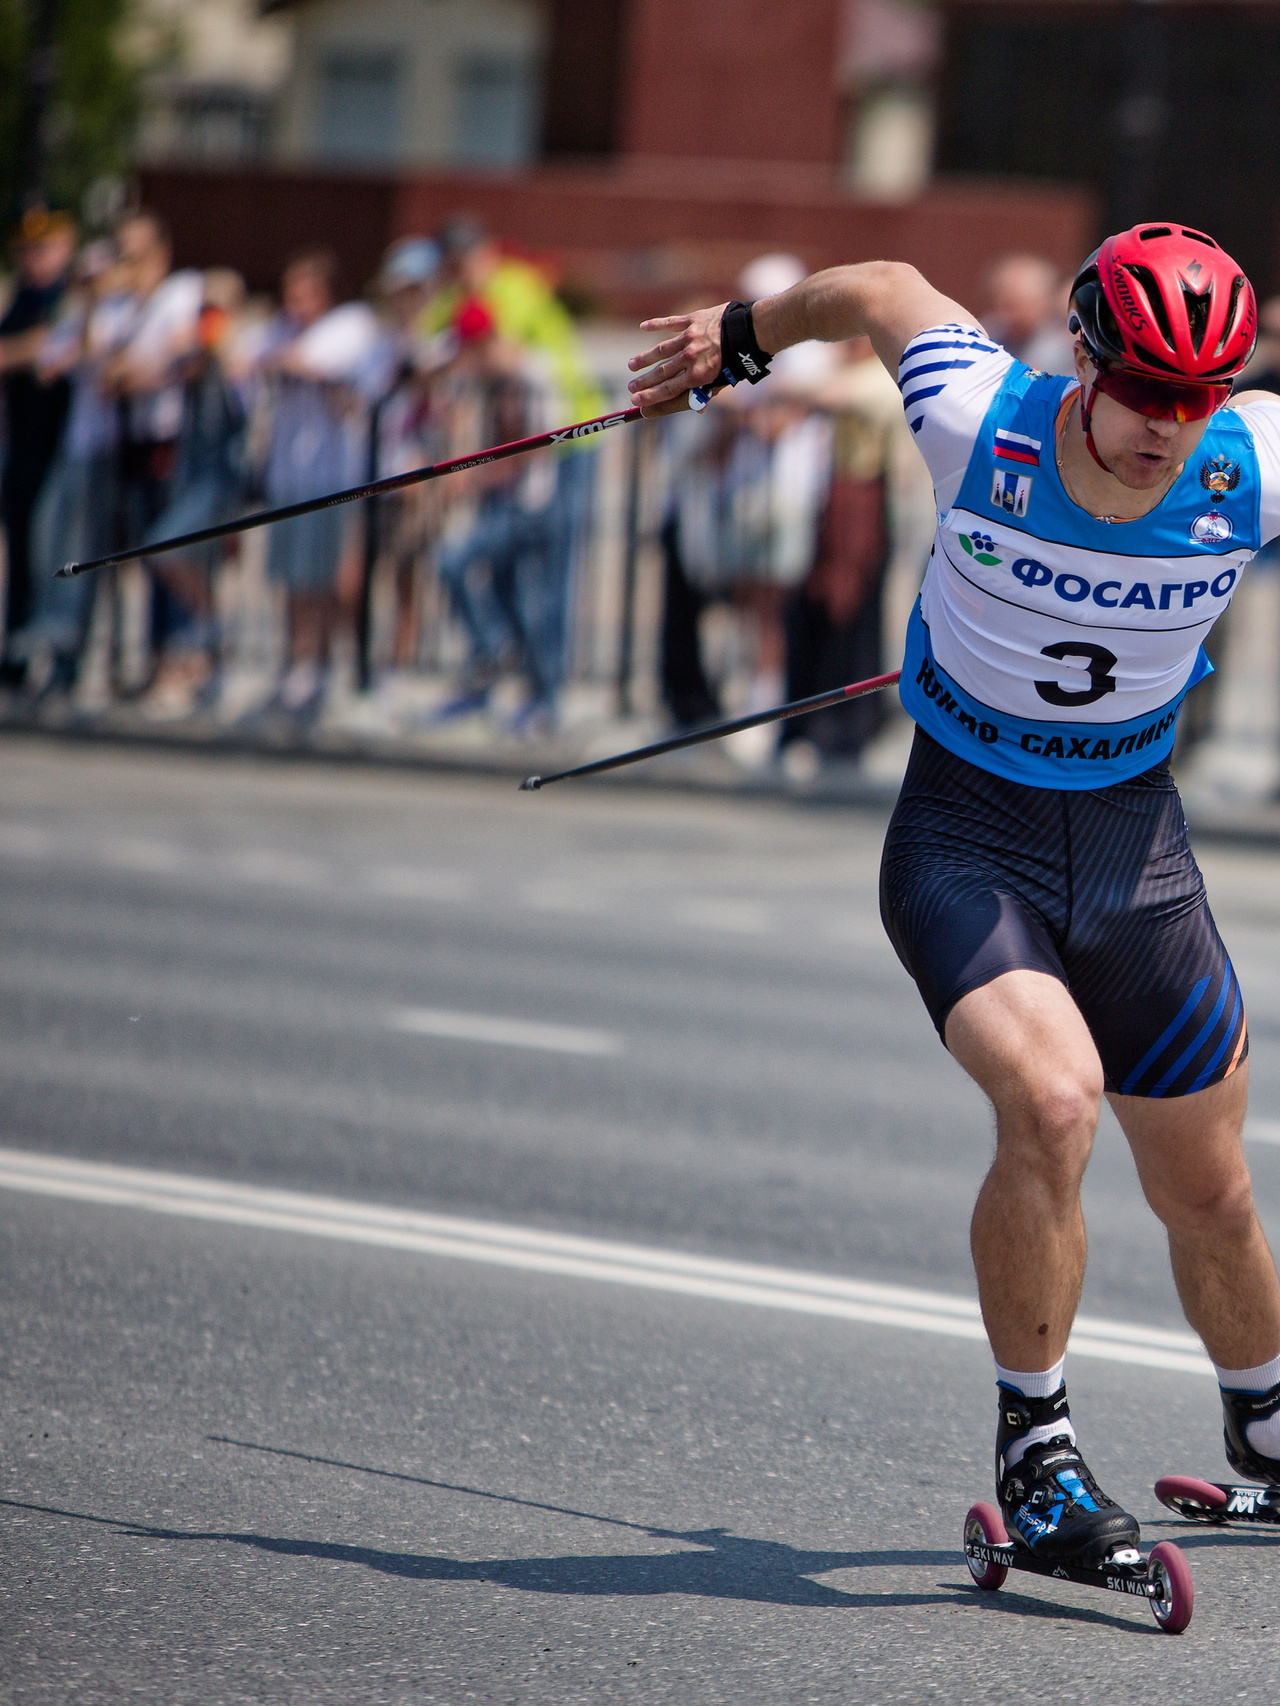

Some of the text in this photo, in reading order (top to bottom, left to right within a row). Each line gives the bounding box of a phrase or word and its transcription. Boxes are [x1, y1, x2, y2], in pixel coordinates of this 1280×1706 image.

[1111, 254, 1150, 332] S-WORKS
[1011, 557, 1237, 611] ФОСАГРО
[1034, 641, 1119, 707] 3
[1042, 1454, 1080, 1467] SPINE
[973, 1546, 1014, 1567] SKI WAY
[1106, 1577, 1149, 1597] SKI WAY
